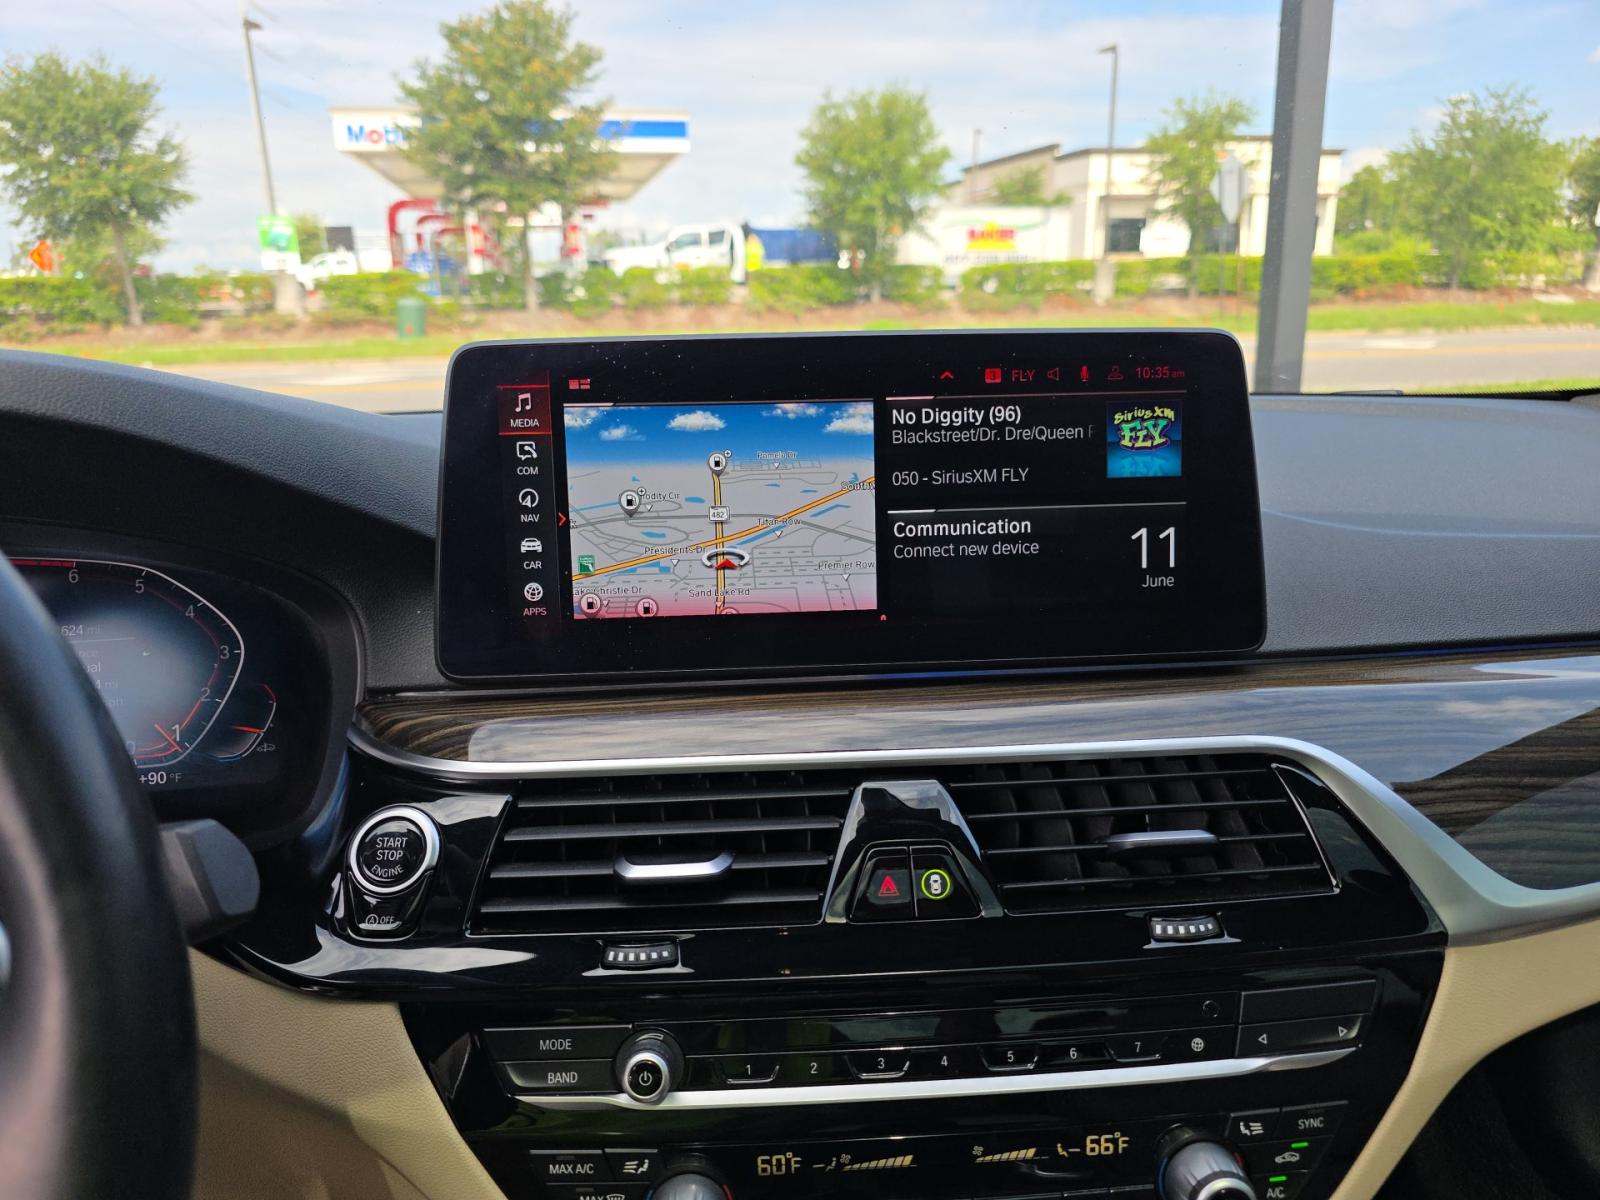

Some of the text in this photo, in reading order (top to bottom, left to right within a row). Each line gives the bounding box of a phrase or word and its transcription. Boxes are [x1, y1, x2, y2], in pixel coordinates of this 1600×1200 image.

[1011, 369, 1035, 382] FLY
[1135, 366, 1186, 379] 10:35 am
[892, 405, 1021, 426] No Diggity (96)
[510, 418, 540, 428] MEDIA
[892, 427, 1001, 444] Blackstreet/Dr.
[1005, 425, 1084, 442] Dre/Queen
[1119, 419, 1168, 447] FLY
[517, 466, 539, 475] COM
[892, 471, 919, 485] 050
[932, 469, 997, 485] SiriusXM
[1002, 467, 1029, 482] FLY
[521, 514, 540, 523] NAV
[711, 511, 725, 519] 482
[893, 519, 1031, 538] Communication
[644, 547, 692, 556] Presidents
[893, 541, 1040, 558] Connect new device
[1131, 527, 1176, 569] 11
[523, 561, 542, 570] CAR
[856, 560, 875, 568] Row
[68, 570, 79, 583] 6
[1142, 575, 1174, 588] June
[135, 579, 144, 594] 5
[689, 587, 750, 598] Sand Lake Rd
[185, 605, 195, 619] 4
[523, 606, 547, 616] APPS
[61, 625, 84, 637] 624
[220, 645, 229, 659] 3
[200, 687, 209, 699] 2
[172, 724, 180, 741] 1
[139, 772, 166, 784] +90
[376, 837, 408, 848] START
[376, 850, 404, 861] STOP
[371, 865, 404, 877] ENGINE
[539, 1039, 572, 1051] MODE
[1134, 1042, 1141, 1053] 7
[1007, 1051, 1014, 1062] 5
[1069, 1048, 1077, 1060] 6
[878, 1058, 885, 1069] 3
[941, 1055, 948, 1067] 4
[746, 1065, 751, 1075] 1
[810, 1062, 818, 1074] 2
[547, 1072, 578, 1084] BAND
[1298, 1117, 1324, 1129] SYNC
[549, 1164, 594, 1174] MAX A/C
[1266, 1186, 1285, 1198] A/C
